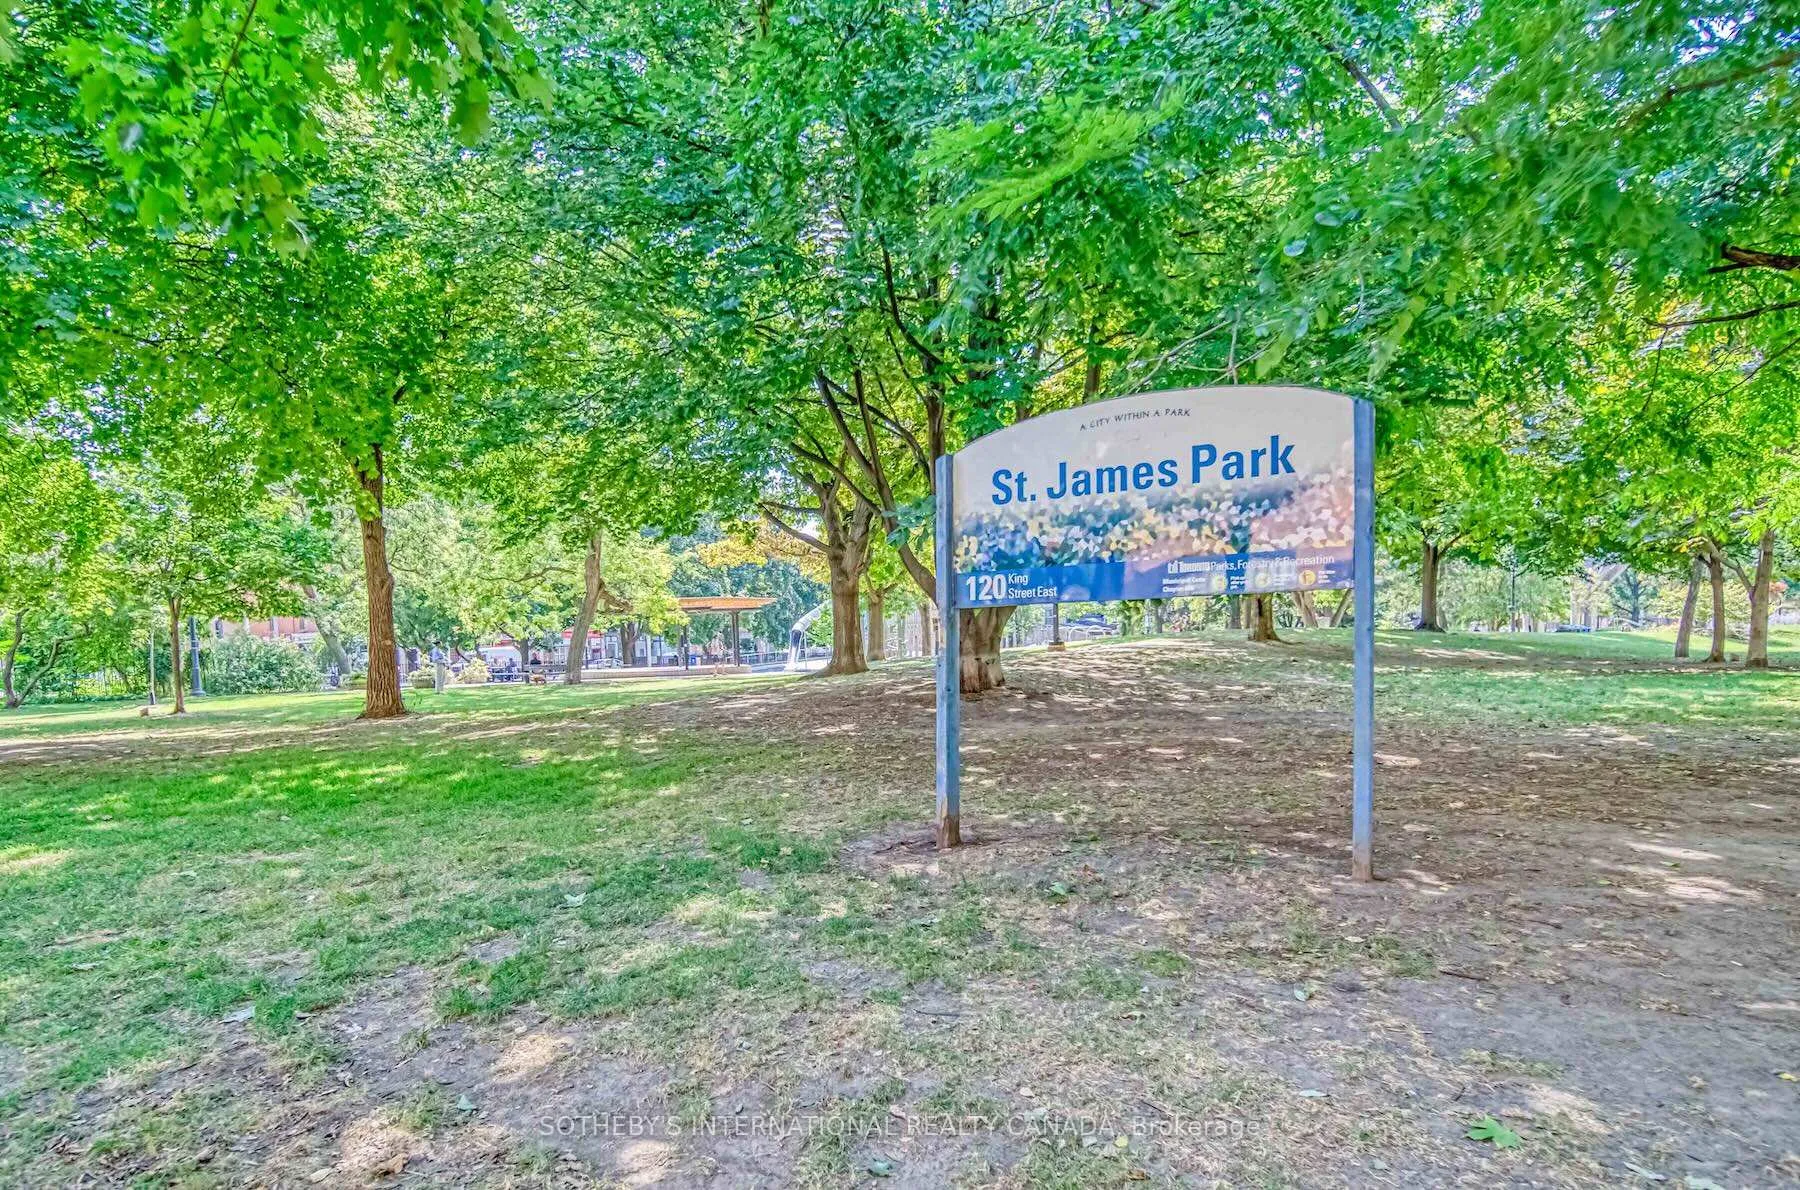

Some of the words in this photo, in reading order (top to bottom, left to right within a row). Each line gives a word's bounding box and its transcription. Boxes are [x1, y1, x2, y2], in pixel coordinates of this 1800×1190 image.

[1089, 417, 1110, 428] CITY
[1114, 410, 1150, 422] WITHIN
[1164, 408, 1191, 417] PARK
[992, 469, 1037, 506] St.
[1046, 459, 1179, 500] James
[1191, 435, 1296, 484] Park
[966, 574, 1007, 601] 120
[1008, 573, 1029, 586] King
[1008, 588, 1036, 599] Street
[1037, 586, 1057, 597] East
